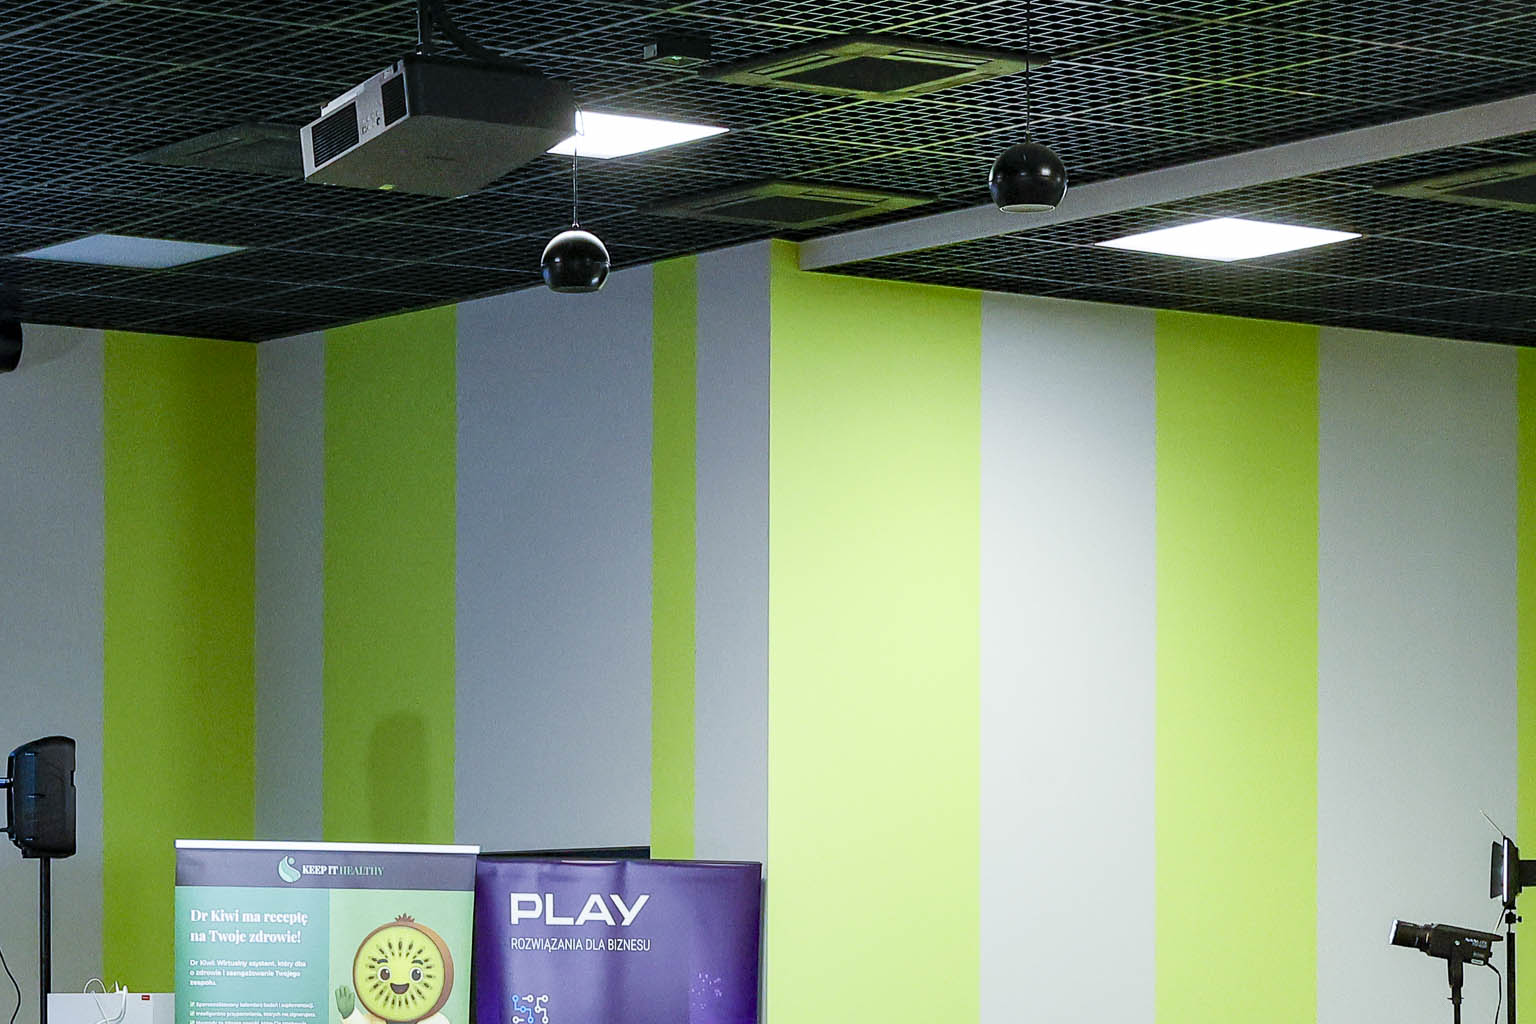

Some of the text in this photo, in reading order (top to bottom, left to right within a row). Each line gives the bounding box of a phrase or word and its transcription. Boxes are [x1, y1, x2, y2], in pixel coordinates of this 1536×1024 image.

[302, 864, 384, 876] KEEP IT HEALTHY
[510, 892, 650, 926] PLAY
[190, 909, 308, 926] Dr Kiwi ma receptę
[190, 930, 302, 945] na Twoje zdrowie!
[511, 937, 651, 953] ROZWIĄZANIA DLA BIZNESU
